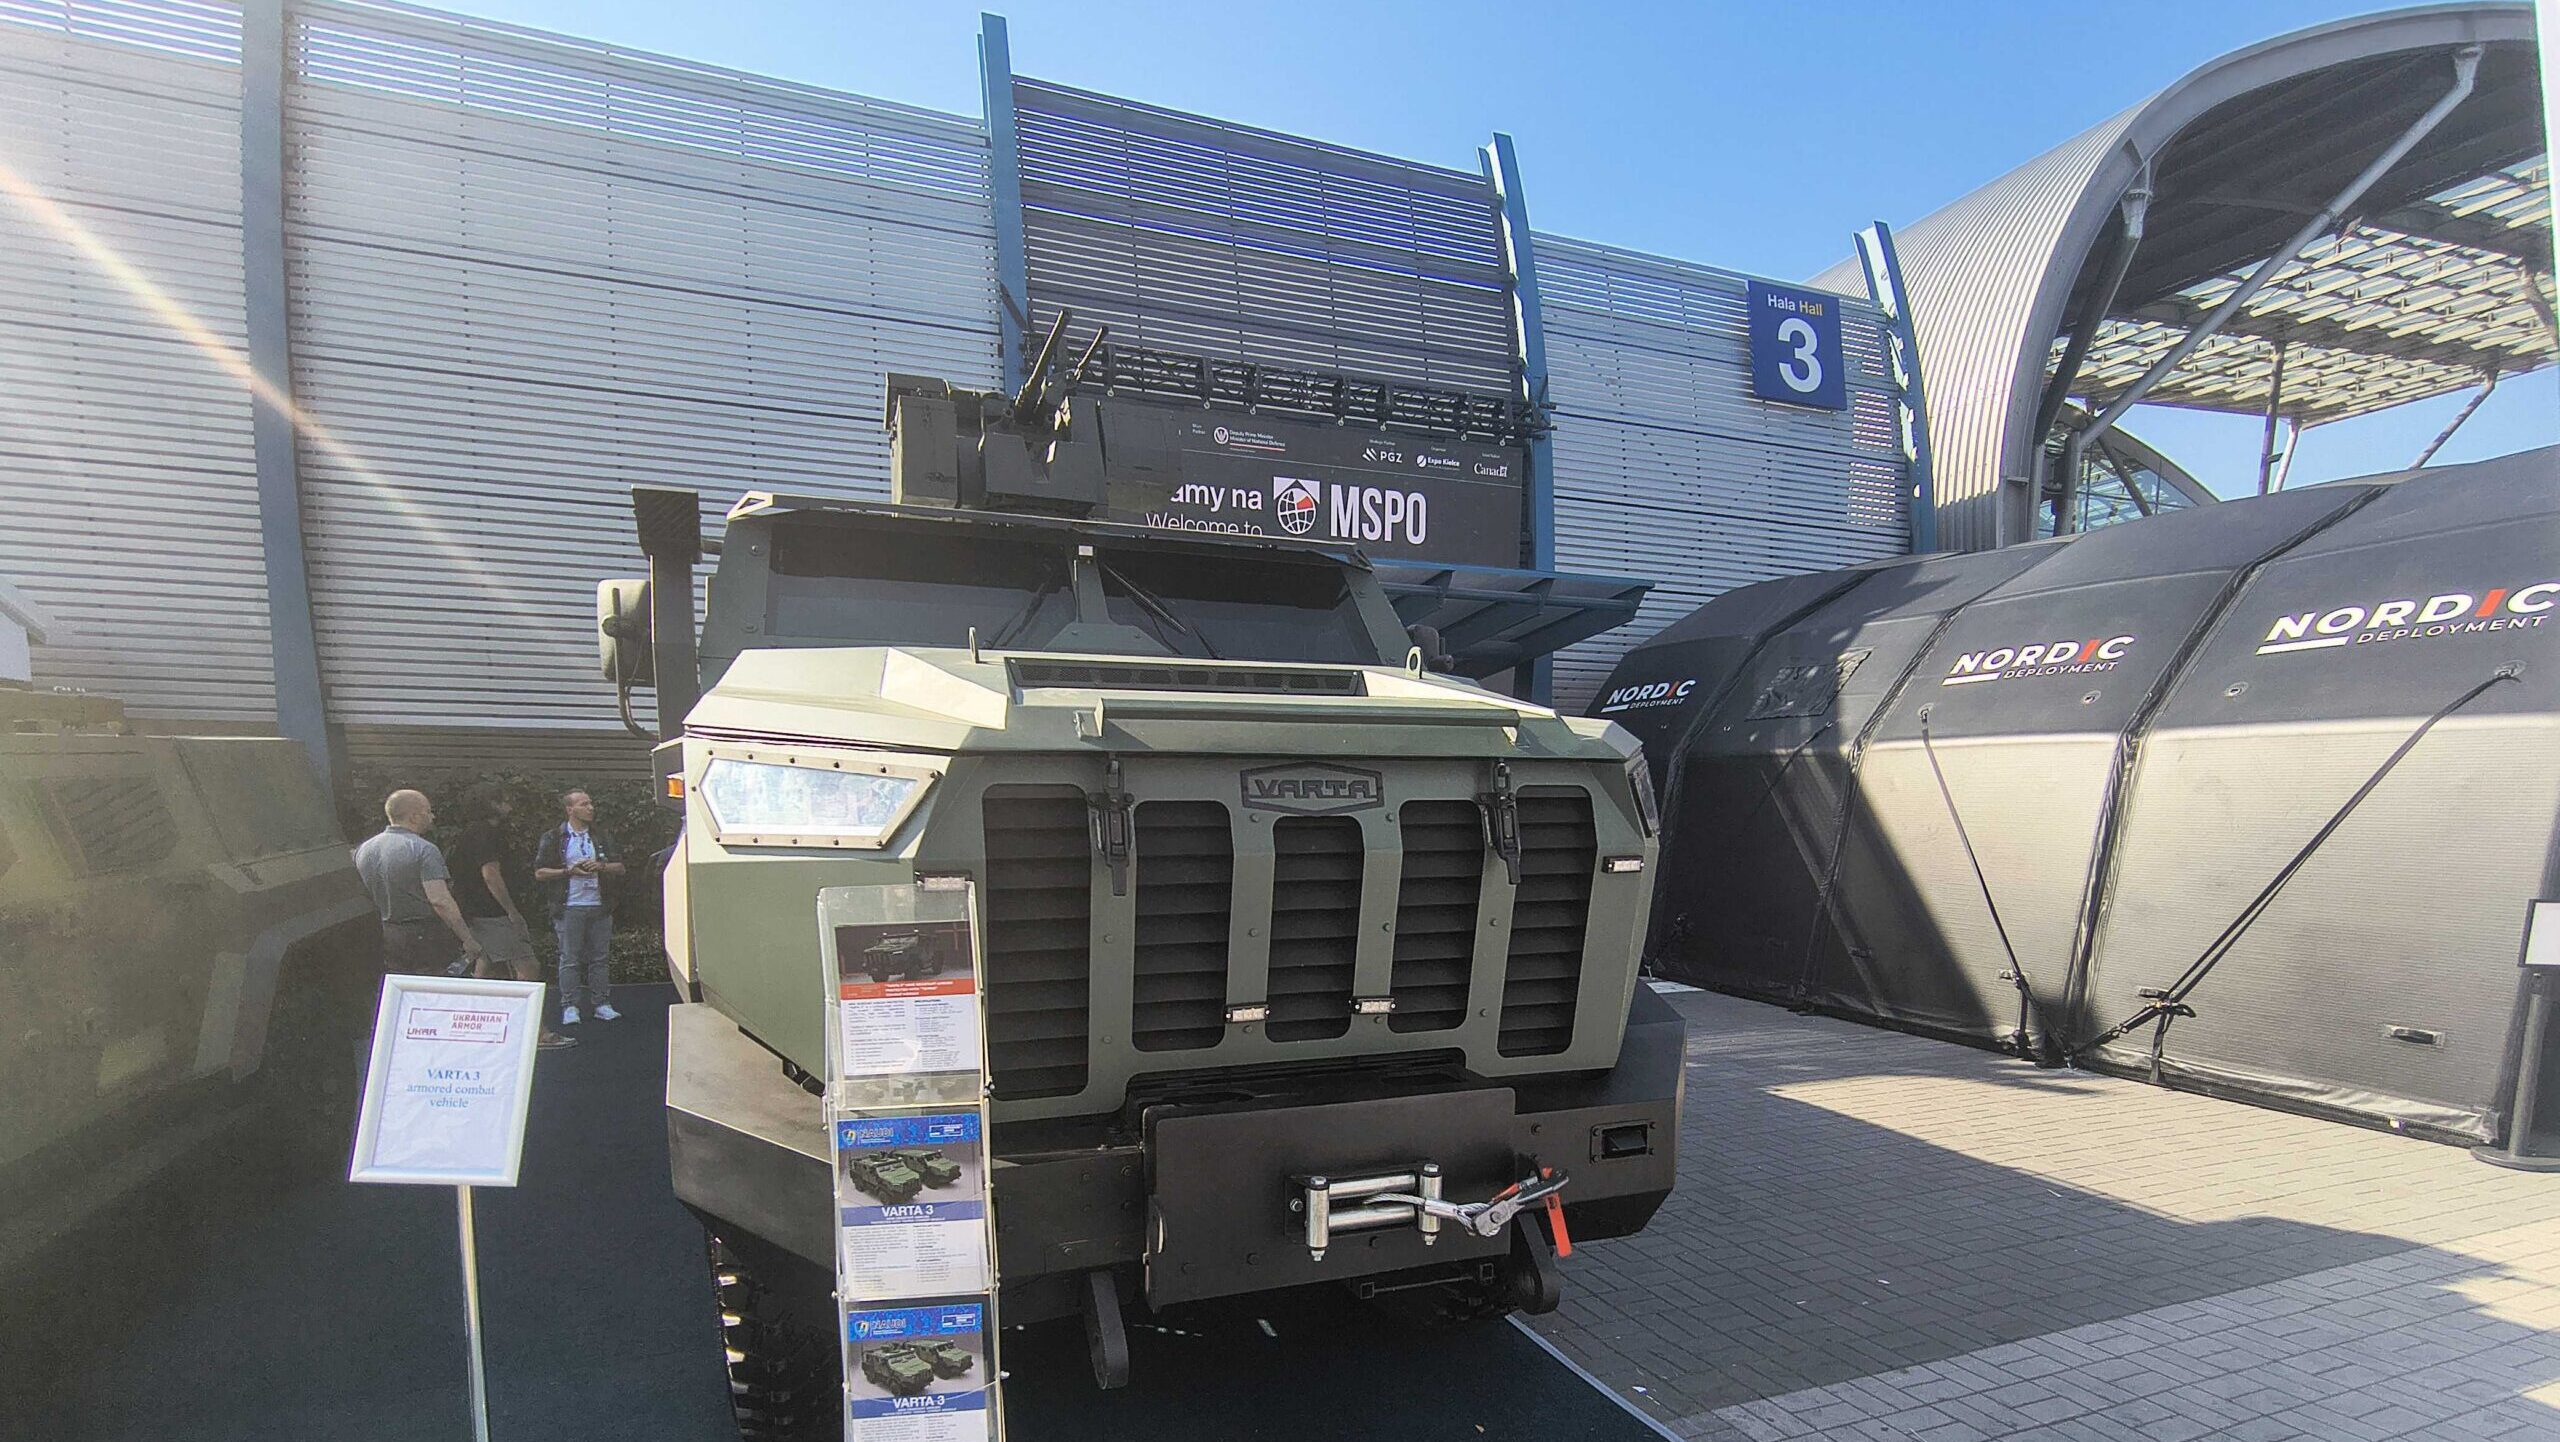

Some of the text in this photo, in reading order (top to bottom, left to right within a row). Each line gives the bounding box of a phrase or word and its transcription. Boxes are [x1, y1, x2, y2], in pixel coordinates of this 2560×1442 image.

[1767, 294, 1823, 316] Hala Hall
[1777, 317, 1822, 393] 3
[1380, 450, 1403, 464] PGZ
[1427, 456, 1442, 466] Expo
[1474, 462, 1508, 478] Canada
[1232, 488, 1263, 511] na
[1330, 484, 1427, 545] MSPO
[1145, 512, 1263, 536] Welcome to
[2264, 582, 2560, 642] NORDIC
[2356, 615, 2548, 644] DEPLOYMENT
[1949, 635, 2135, 675] NORDIC
[2003, 661, 2119, 680] DEPLOYMENT
[1606, 680, 1697, 705] NORDIC
[1630, 698, 1686, 709] DEPLOYMENT
[1254, 779, 1371, 799] VARTA
[451, 1022, 483, 1030] ARMOR
[452, 1013, 503, 1023] UKRAINIAN
[427, 1068, 481, 1081] VARTA 3
[406, 1083, 496, 1095] armored combat
[430, 1097, 469, 1108] vehicle
[881, 1204, 934, 1217] VARTA 3
[892, 1395, 945, 1409] VARTA 3
